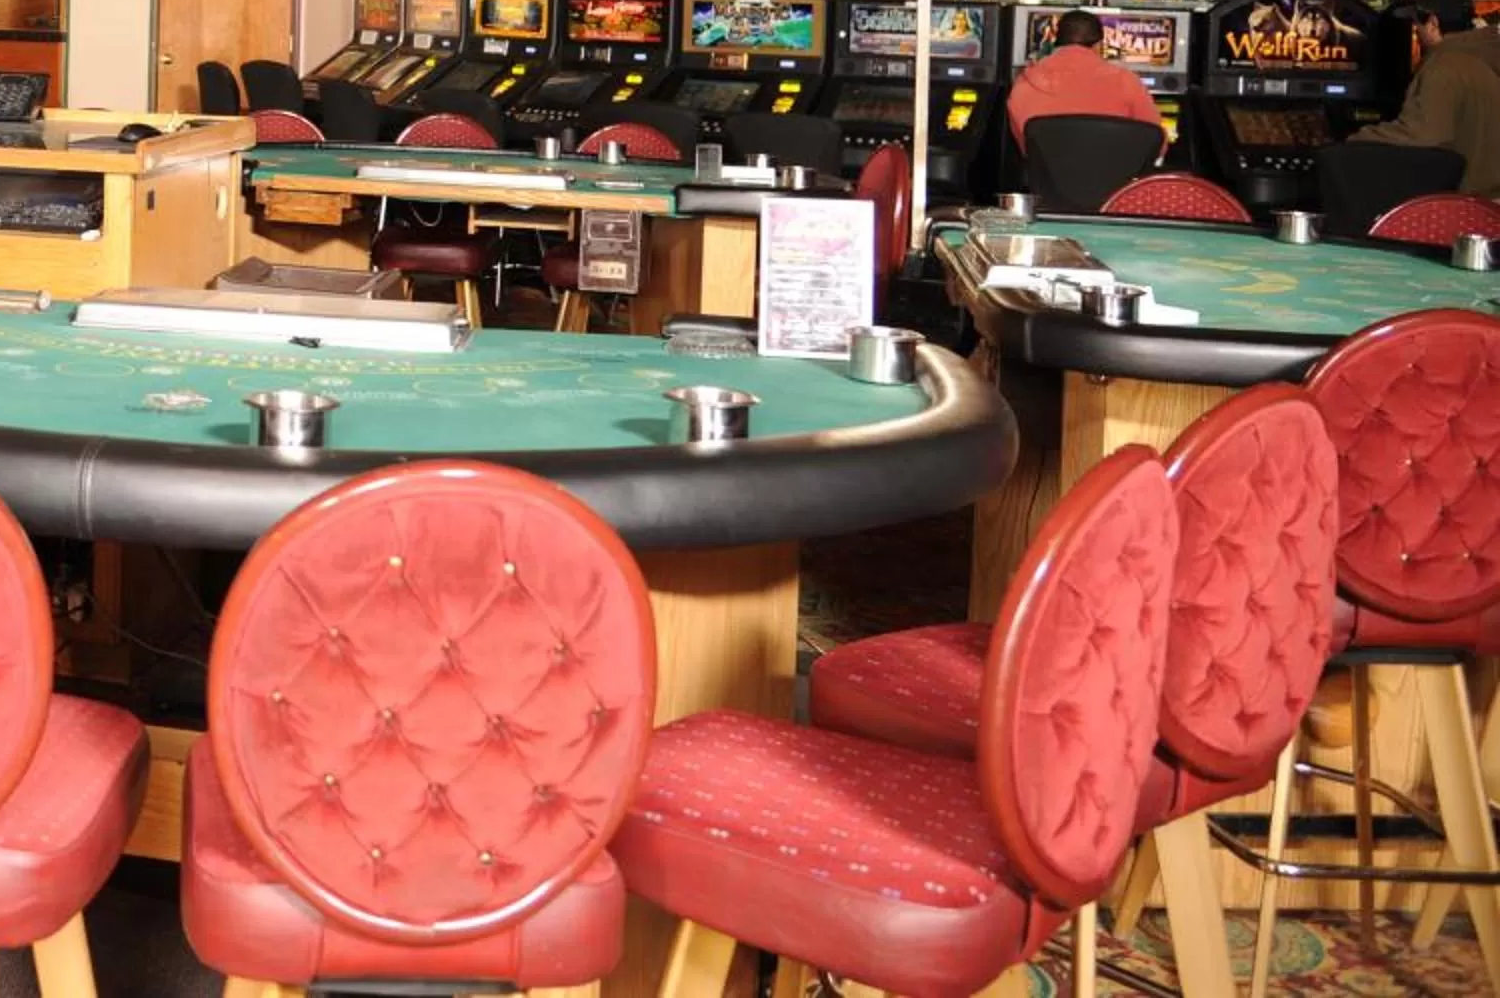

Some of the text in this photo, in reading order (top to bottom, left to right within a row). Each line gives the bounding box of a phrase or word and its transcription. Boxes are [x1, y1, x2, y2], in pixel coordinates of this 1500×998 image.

[1103, 25, 1171, 58] RMAID
[1226, 31, 1349, 60] Wolf Run
